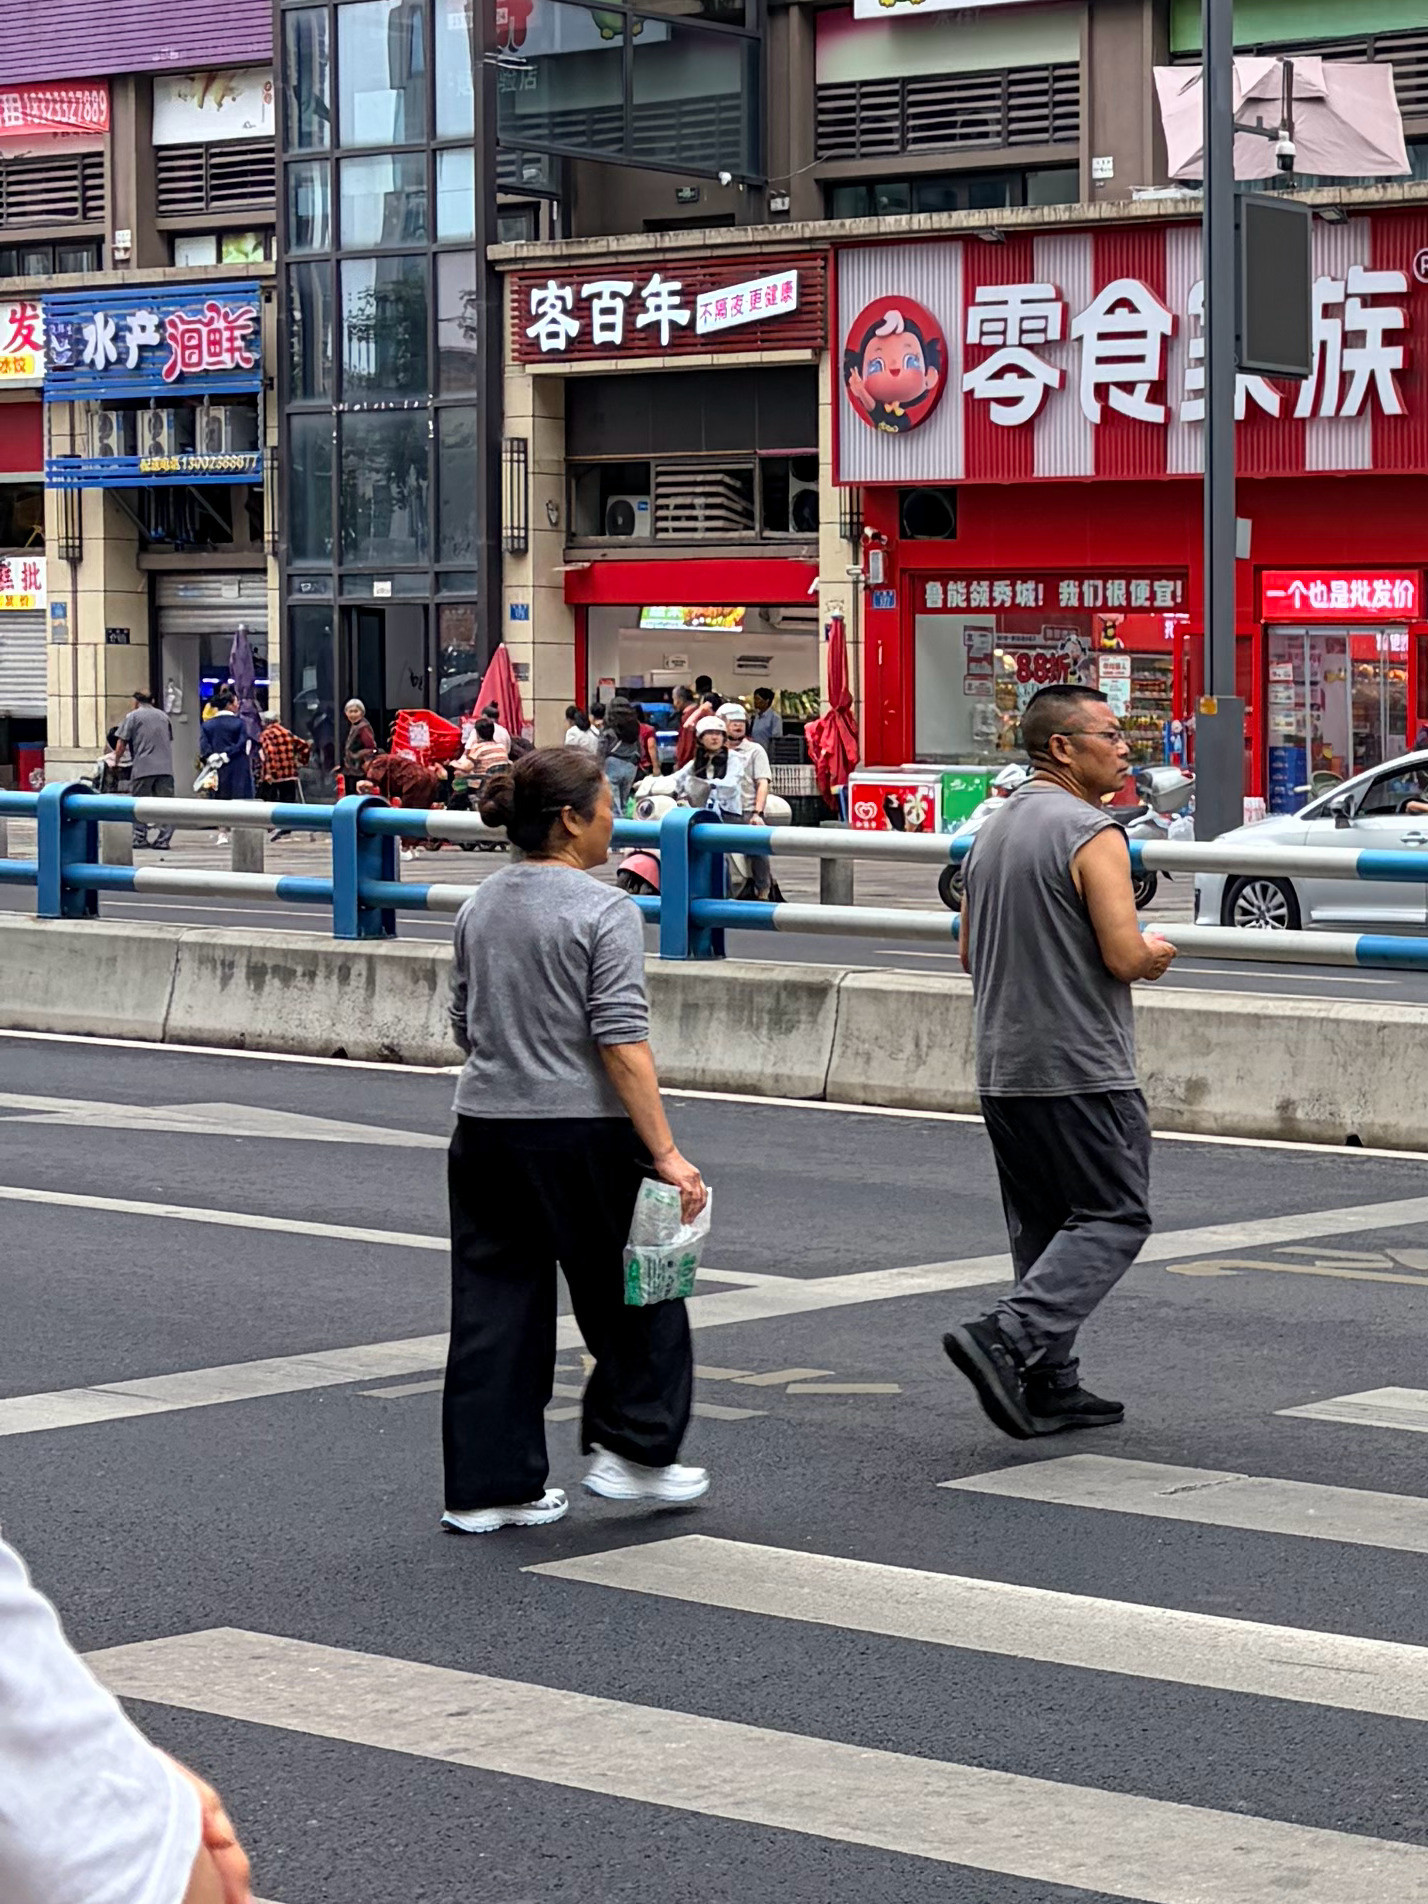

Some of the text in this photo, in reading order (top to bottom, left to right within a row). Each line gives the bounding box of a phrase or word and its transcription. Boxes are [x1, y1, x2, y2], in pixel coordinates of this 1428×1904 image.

[7, 301, 45, 354] 发
[525, 272, 691, 353] 客百年
[962, 264, 1413, 427] 零食族
[925, 579, 1183, 608] 鲁能领秀城! 我们很便宜!
[1265, 579, 1415, 609] 一个也是批发价
